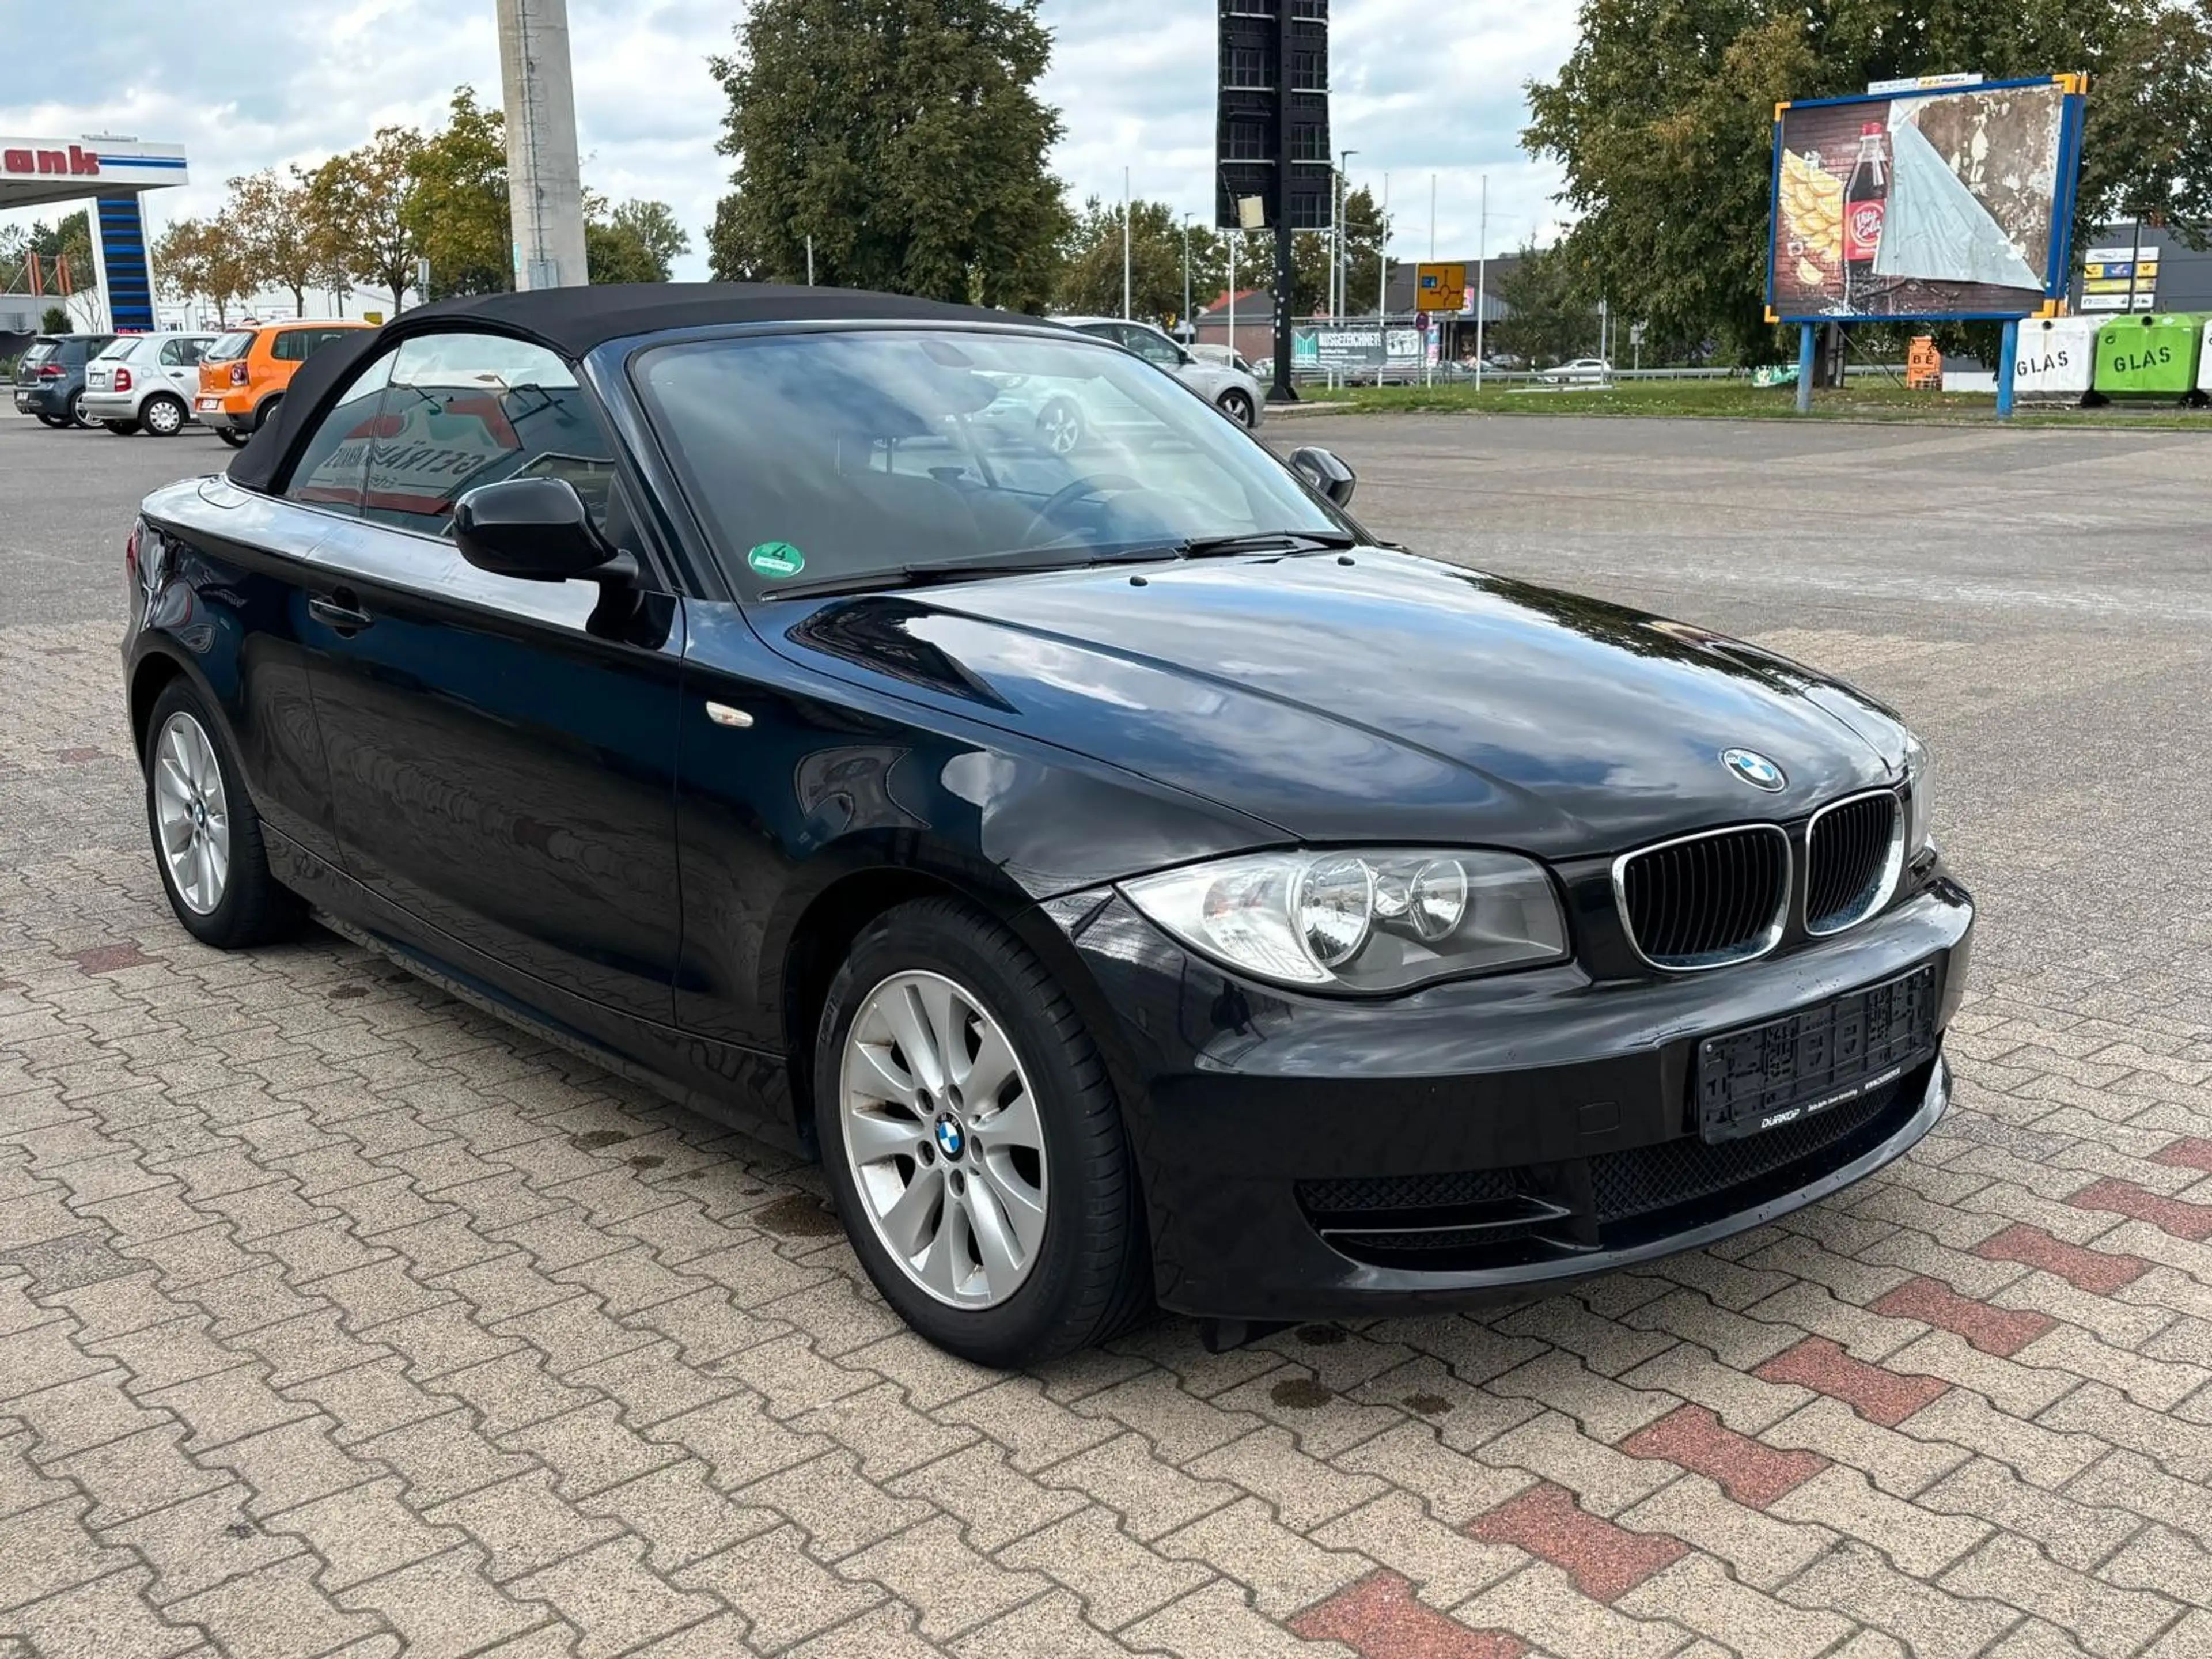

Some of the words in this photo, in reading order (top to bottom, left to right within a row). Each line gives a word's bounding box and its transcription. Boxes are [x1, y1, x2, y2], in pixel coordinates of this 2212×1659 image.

[2016, 350, 2069, 377] GLAS
[2113, 346, 2171, 373] GLAS
[771, 544, 786, 560] 4
